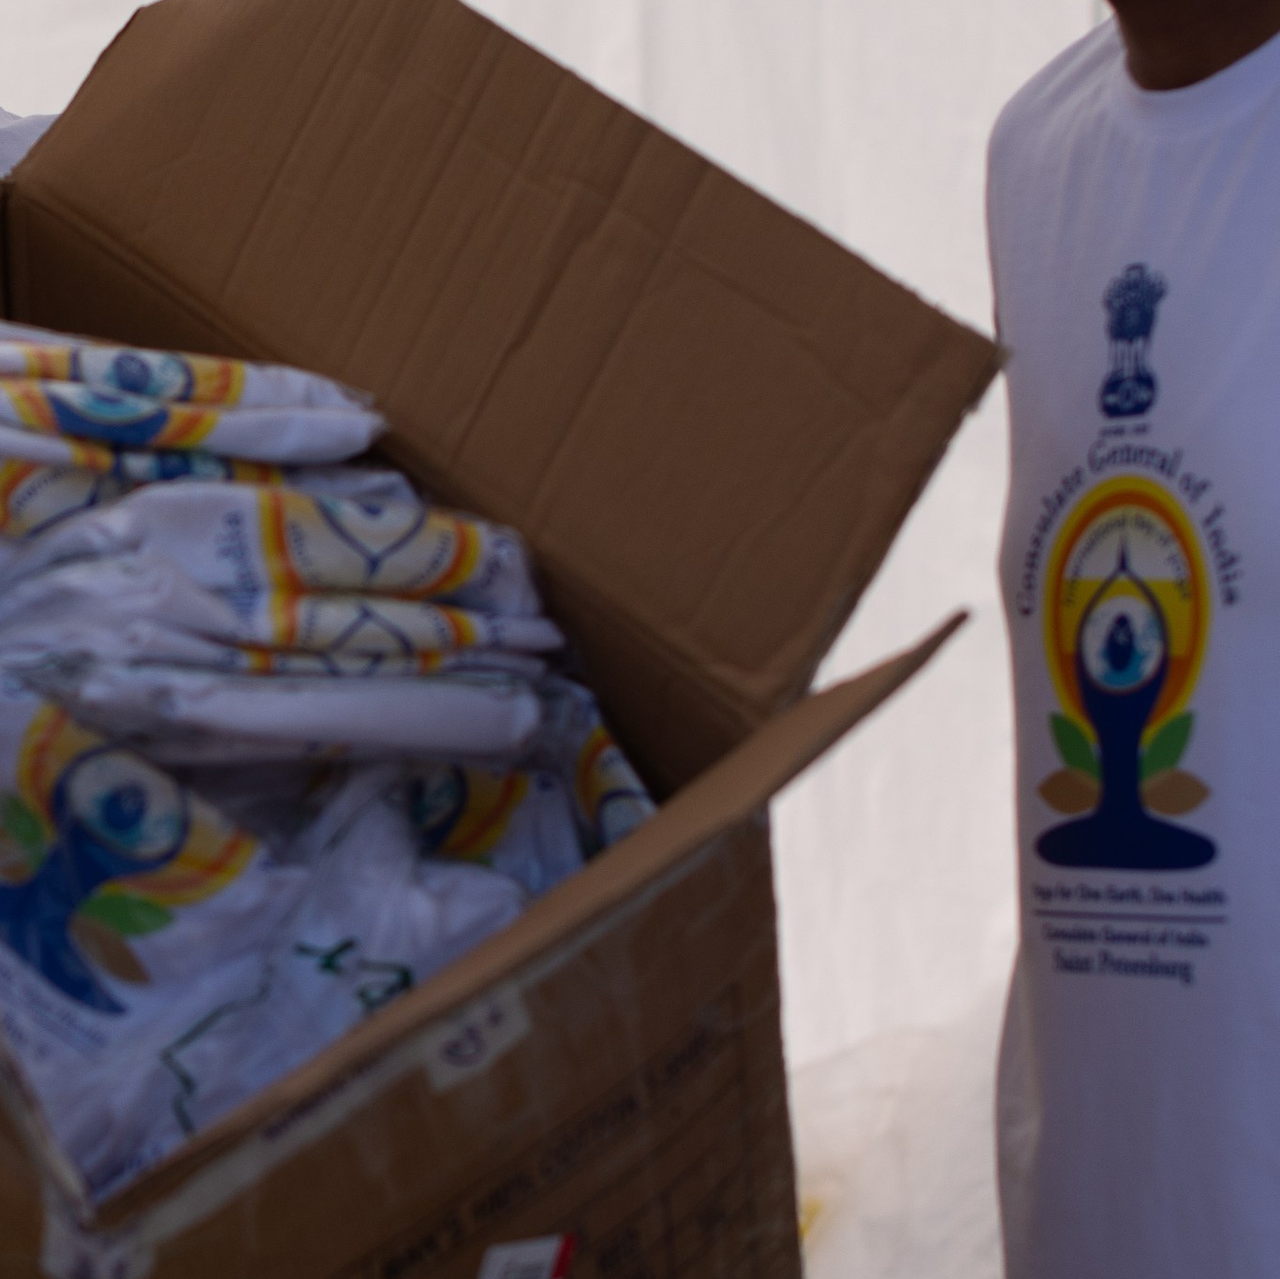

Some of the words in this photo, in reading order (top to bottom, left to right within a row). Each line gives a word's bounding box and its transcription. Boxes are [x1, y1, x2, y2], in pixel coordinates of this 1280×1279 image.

[1018, 467, 1084, 615] Consulate
[1087, 439, 1184, 475] General
[1180, 472, 1211, 503] of
[1204, 505, 1243, 605] India
